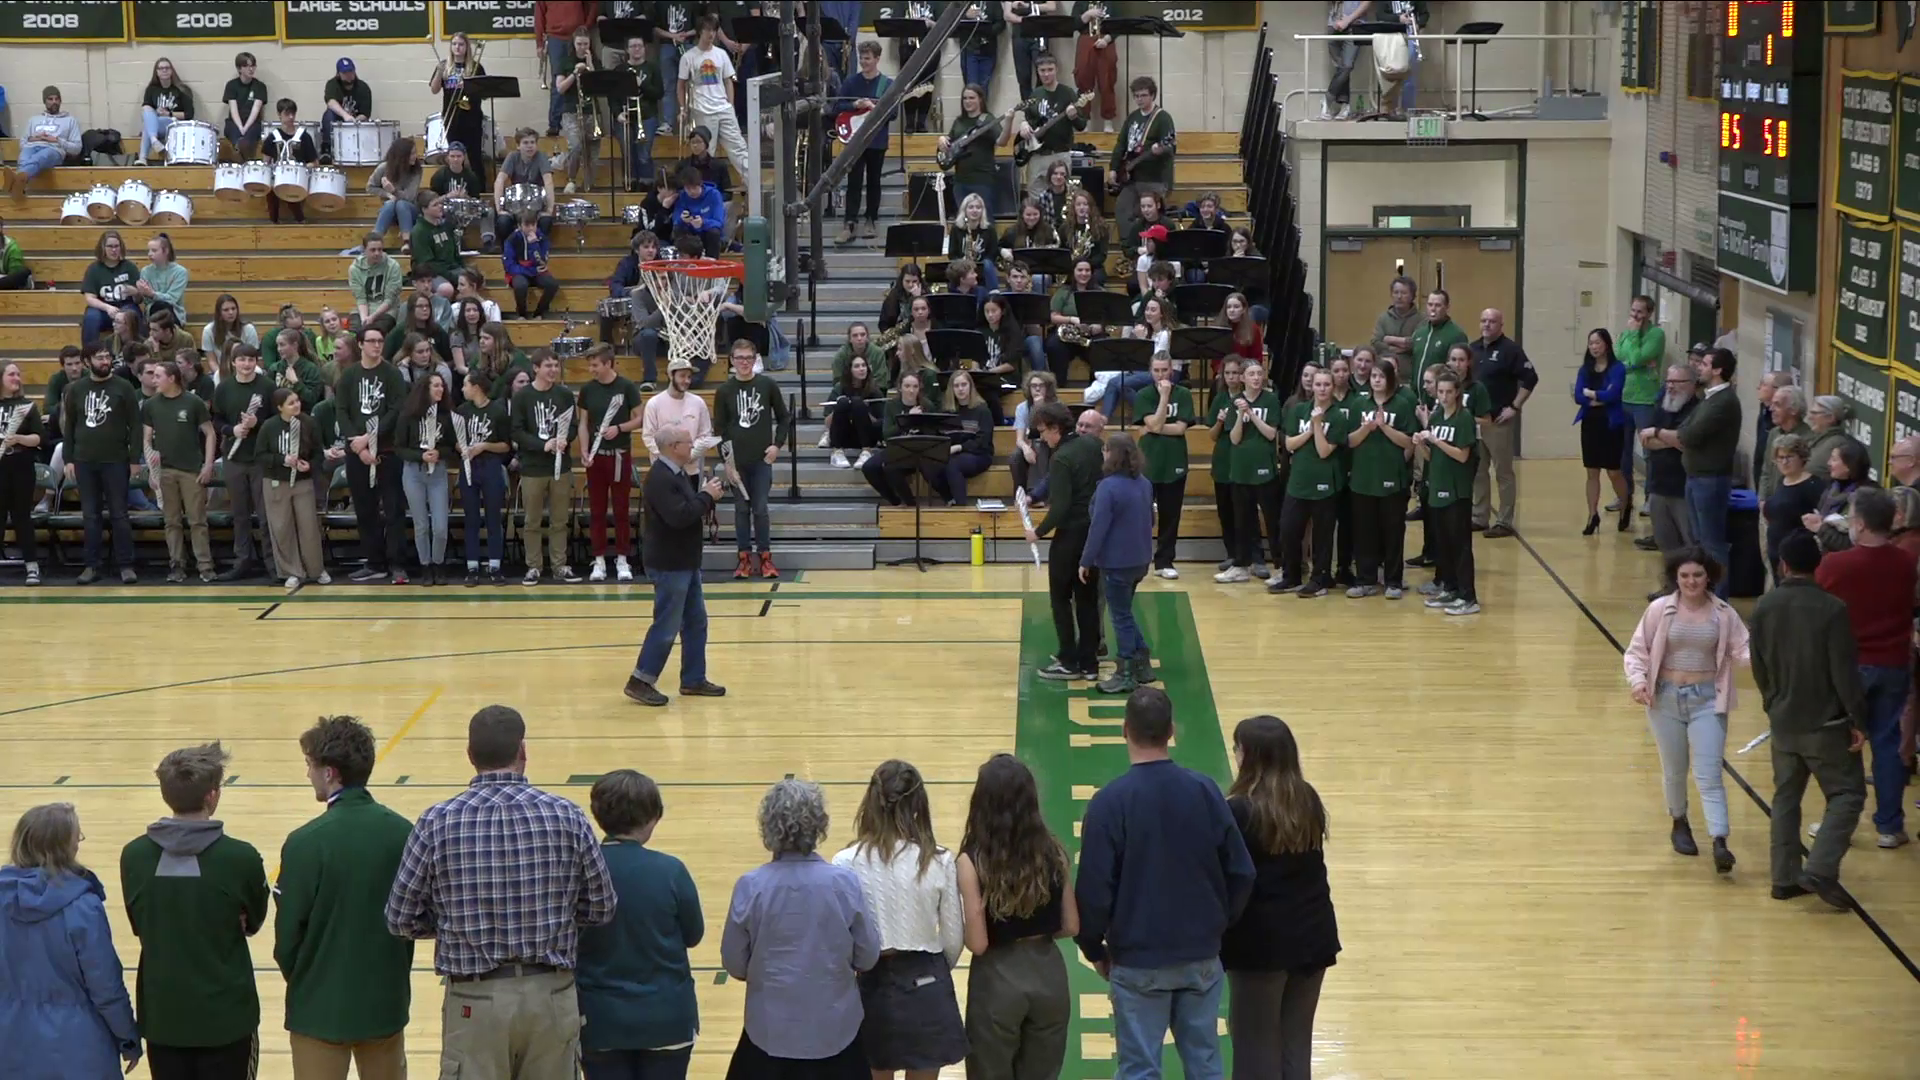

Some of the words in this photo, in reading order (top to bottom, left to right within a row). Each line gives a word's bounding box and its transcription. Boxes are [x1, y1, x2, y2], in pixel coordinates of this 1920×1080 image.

[287, 1, 342, 12] LARGE
[348, 1, 426, 12] SCHOOLS
[446, 1, 501, 10] LARGE
[22, 14, 79, 28] 2008
[176, 13, 232, 28] 2008
[1162, 9, 1203, 21] 2012
[335, 19, 379, 31] 2008
[1416, 119, 1439, 136] EXIT
